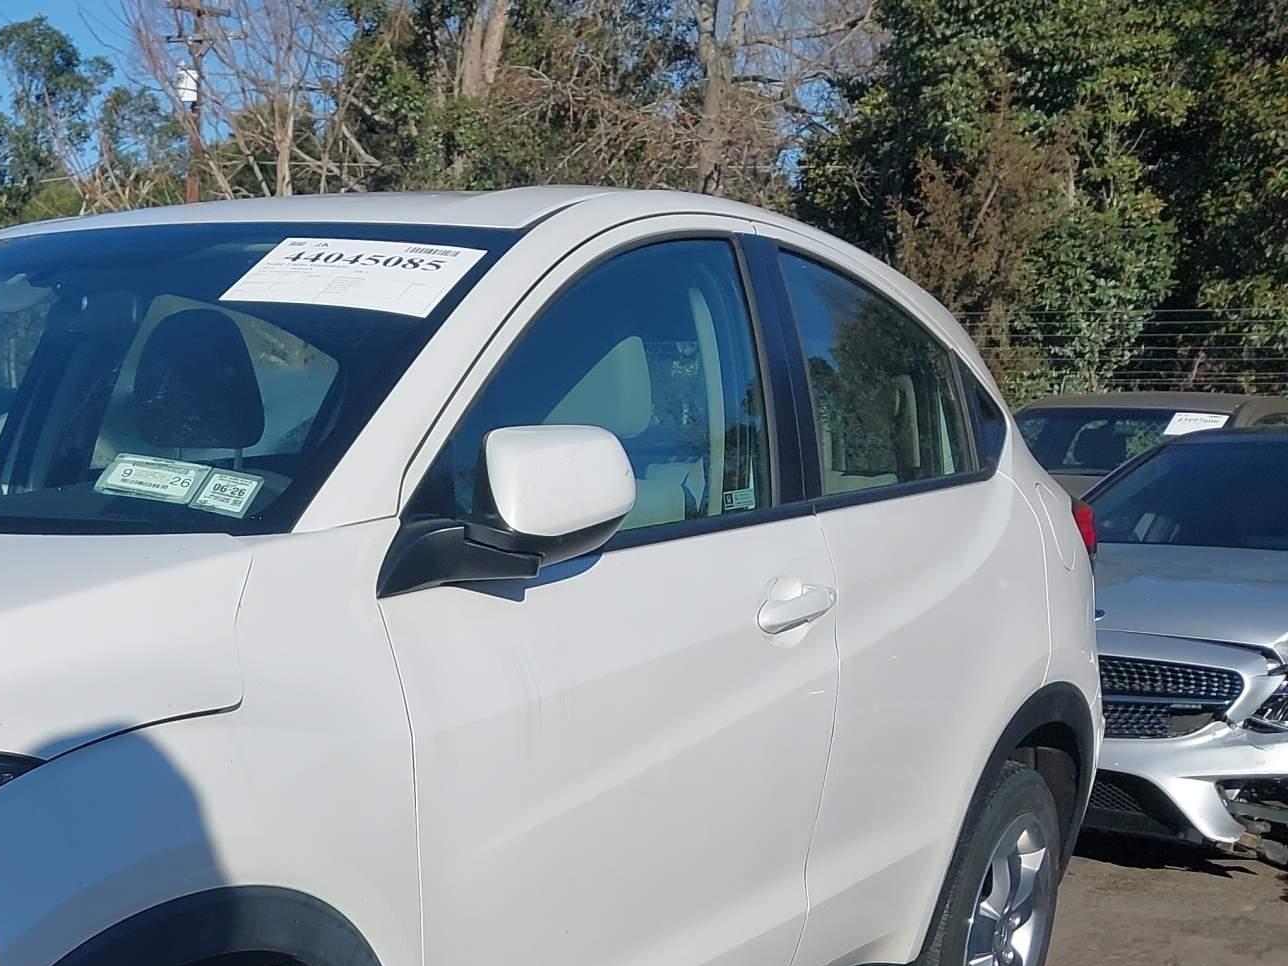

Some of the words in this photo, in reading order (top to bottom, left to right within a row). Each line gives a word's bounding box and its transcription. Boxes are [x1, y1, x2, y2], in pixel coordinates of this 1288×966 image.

[284, 250, 446, 272] 44045085
[121, 468, 133, 478] 9
[169, 476, 192, 488] 26
